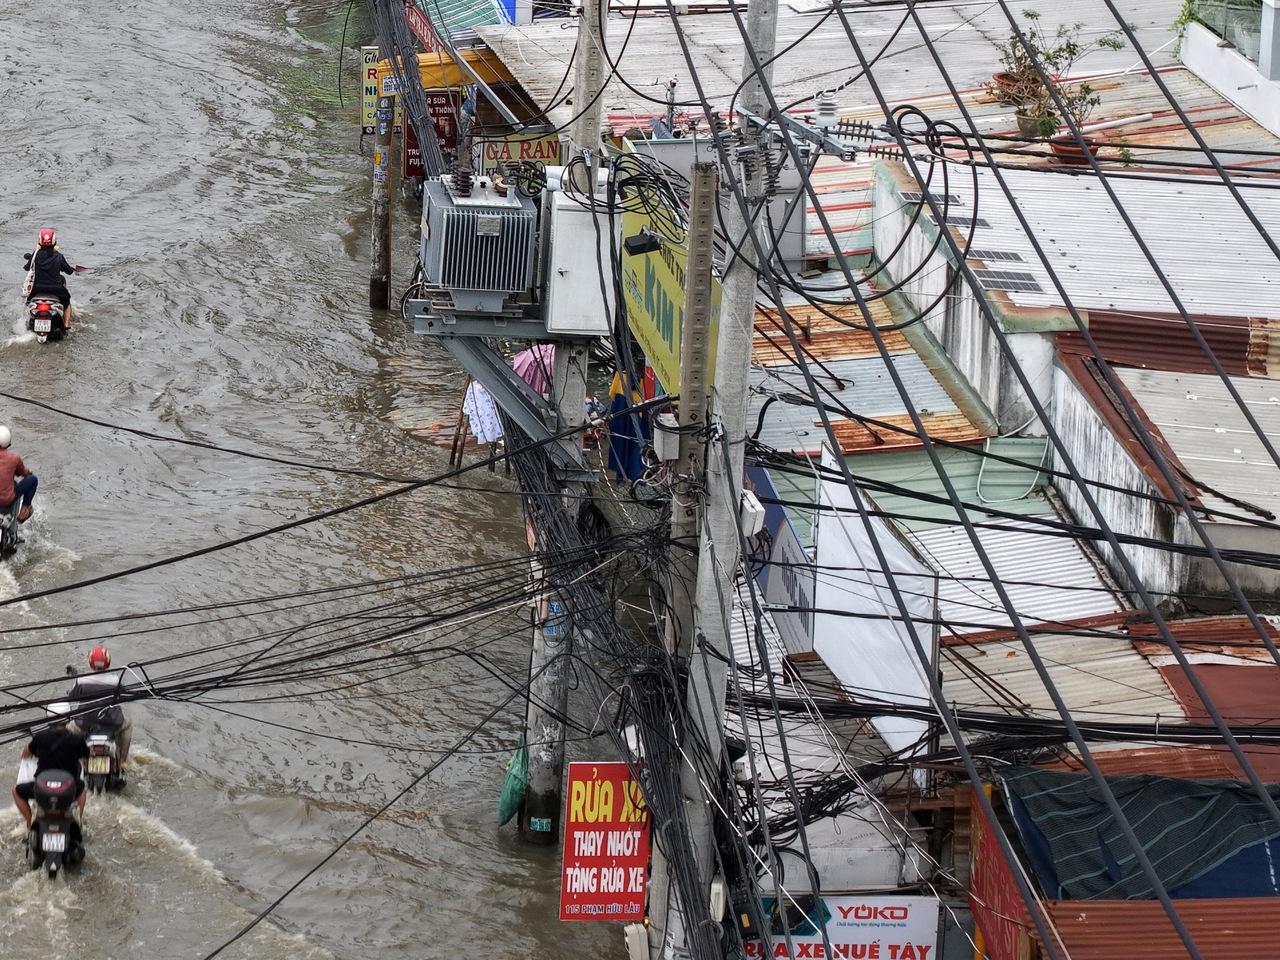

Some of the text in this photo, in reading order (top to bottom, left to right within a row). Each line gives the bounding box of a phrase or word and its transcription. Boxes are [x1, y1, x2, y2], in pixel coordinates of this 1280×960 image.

[486, 136, 513, 161] GÀ
[644, 252, 675, 354] KIM
[570, 767, 614, 823] RỬA
[573, 825, 641, 857] THAY NHỚT
[566, 859, 644, 900] TẶNG RỬA XE
[565, 904, 580, 915] 115
[581, 903, 605, 916] PHẠM
[606, 902, 623, 915] HỮU
[837, 904, 908, 920] YOKO
[834, 939, 880, 959] HUẾ
[888, 941, 932, 960] TÂY
